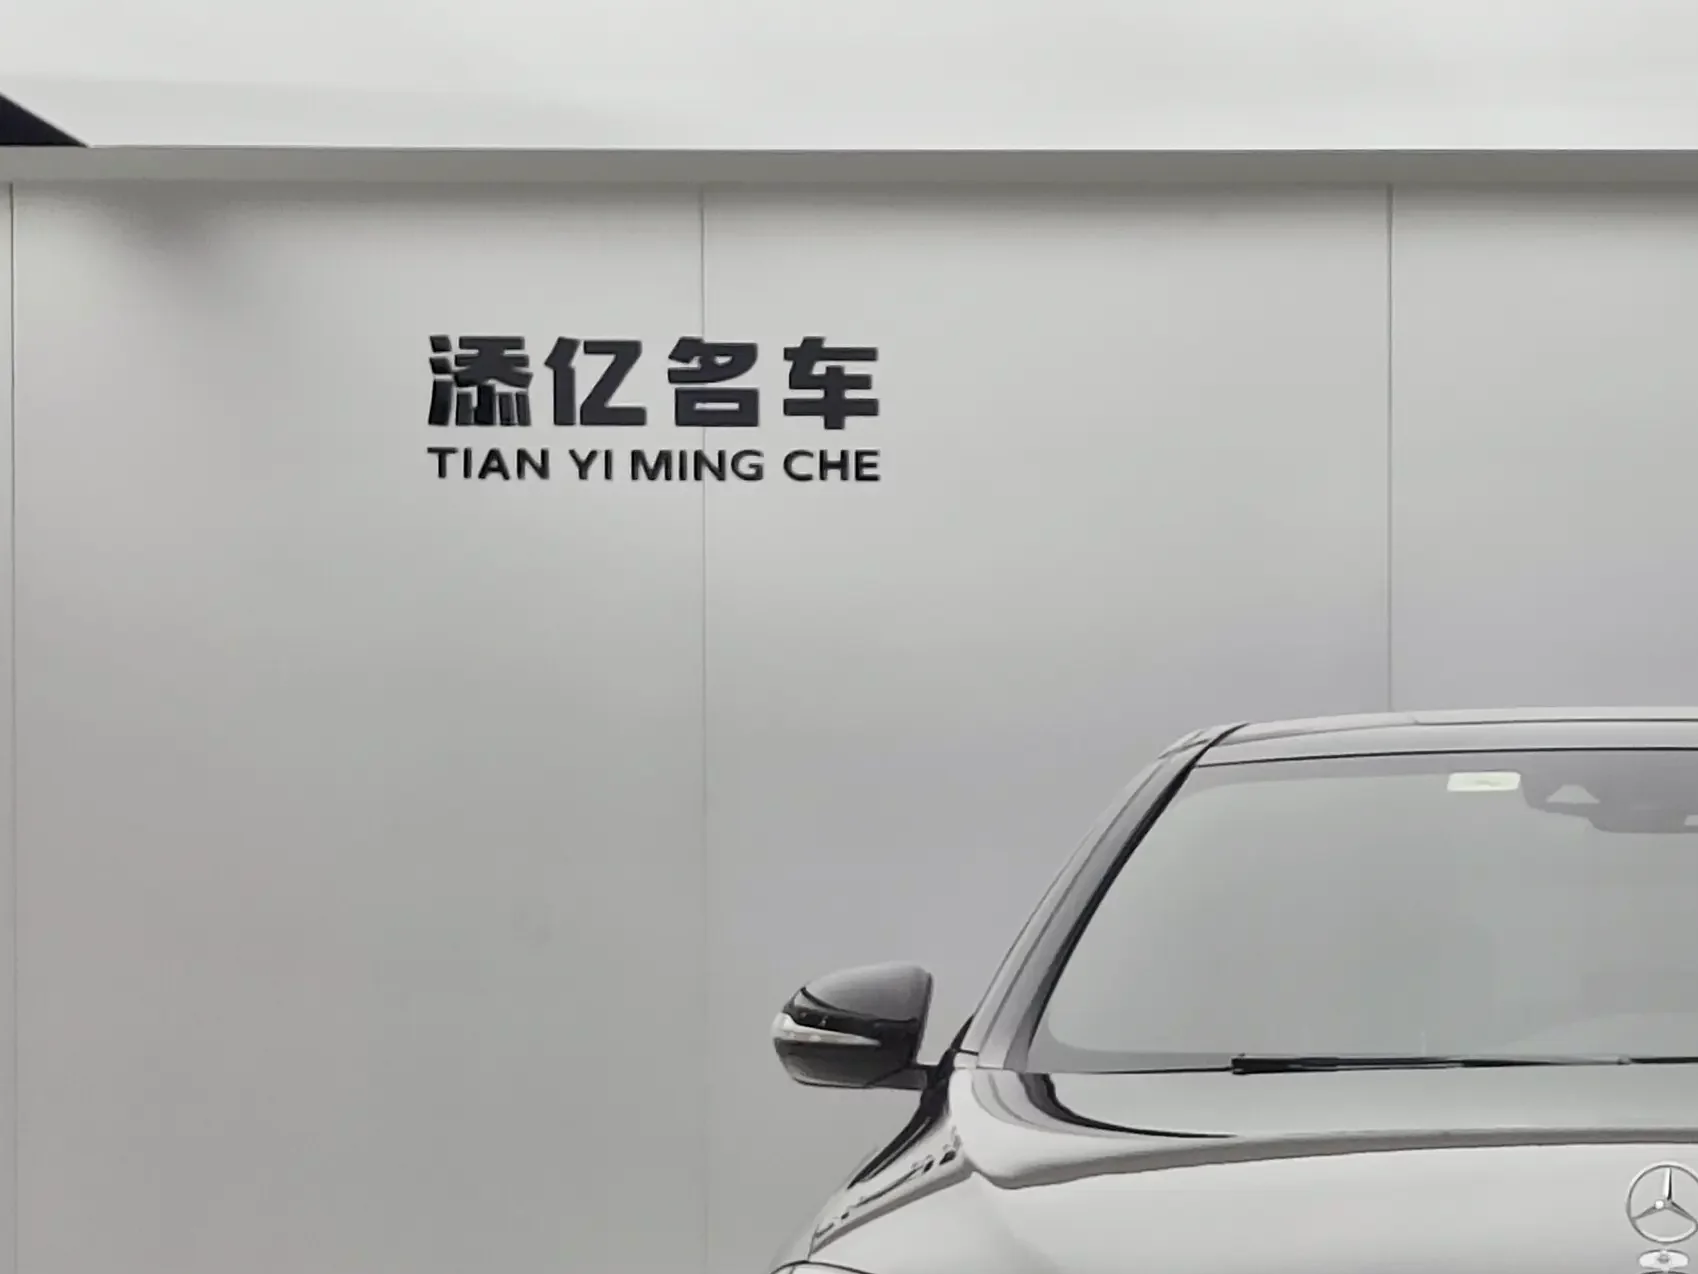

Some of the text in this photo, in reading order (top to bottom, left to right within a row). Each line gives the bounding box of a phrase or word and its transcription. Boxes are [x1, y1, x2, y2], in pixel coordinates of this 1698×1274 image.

[427, 334, 880, 431] 添亿名车
[426, 446, 881, 483] TIAN YI MING CHE
